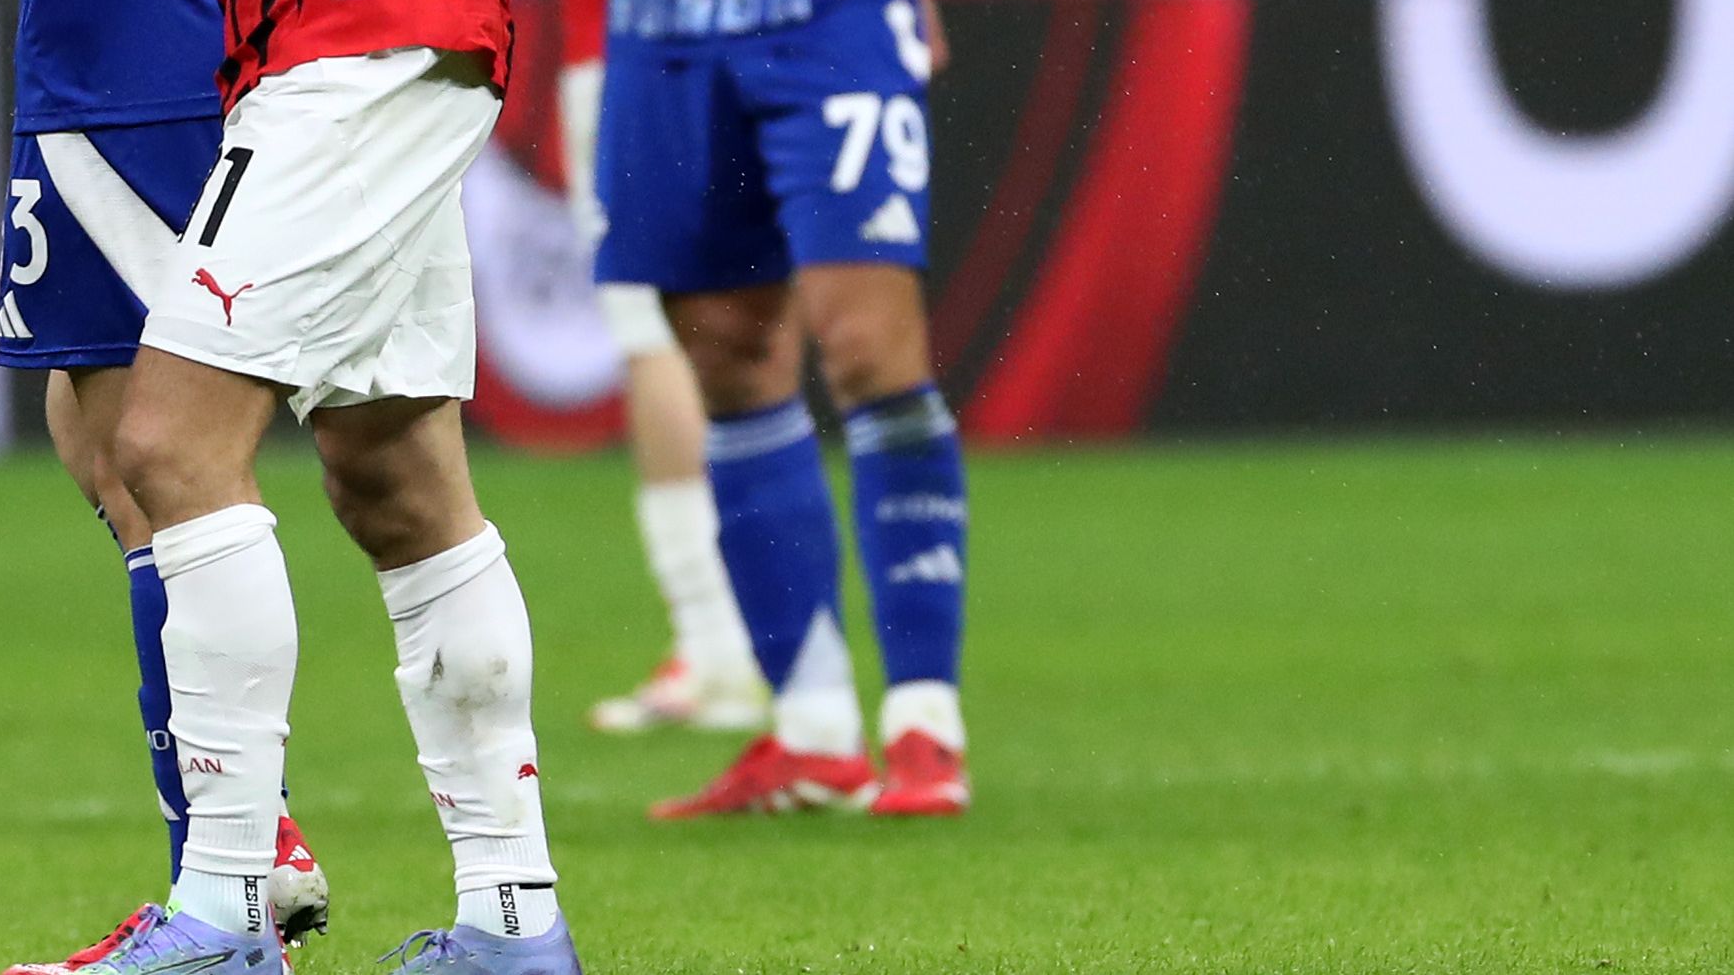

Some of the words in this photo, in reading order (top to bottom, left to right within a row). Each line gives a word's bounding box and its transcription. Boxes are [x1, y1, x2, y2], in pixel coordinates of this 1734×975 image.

[822, 92, 932, 193] 79
[198, 146, 254, 248] 1
[244, 876, 262, 933] DESIGN
[498, 883, 521, 937] DESIGN
